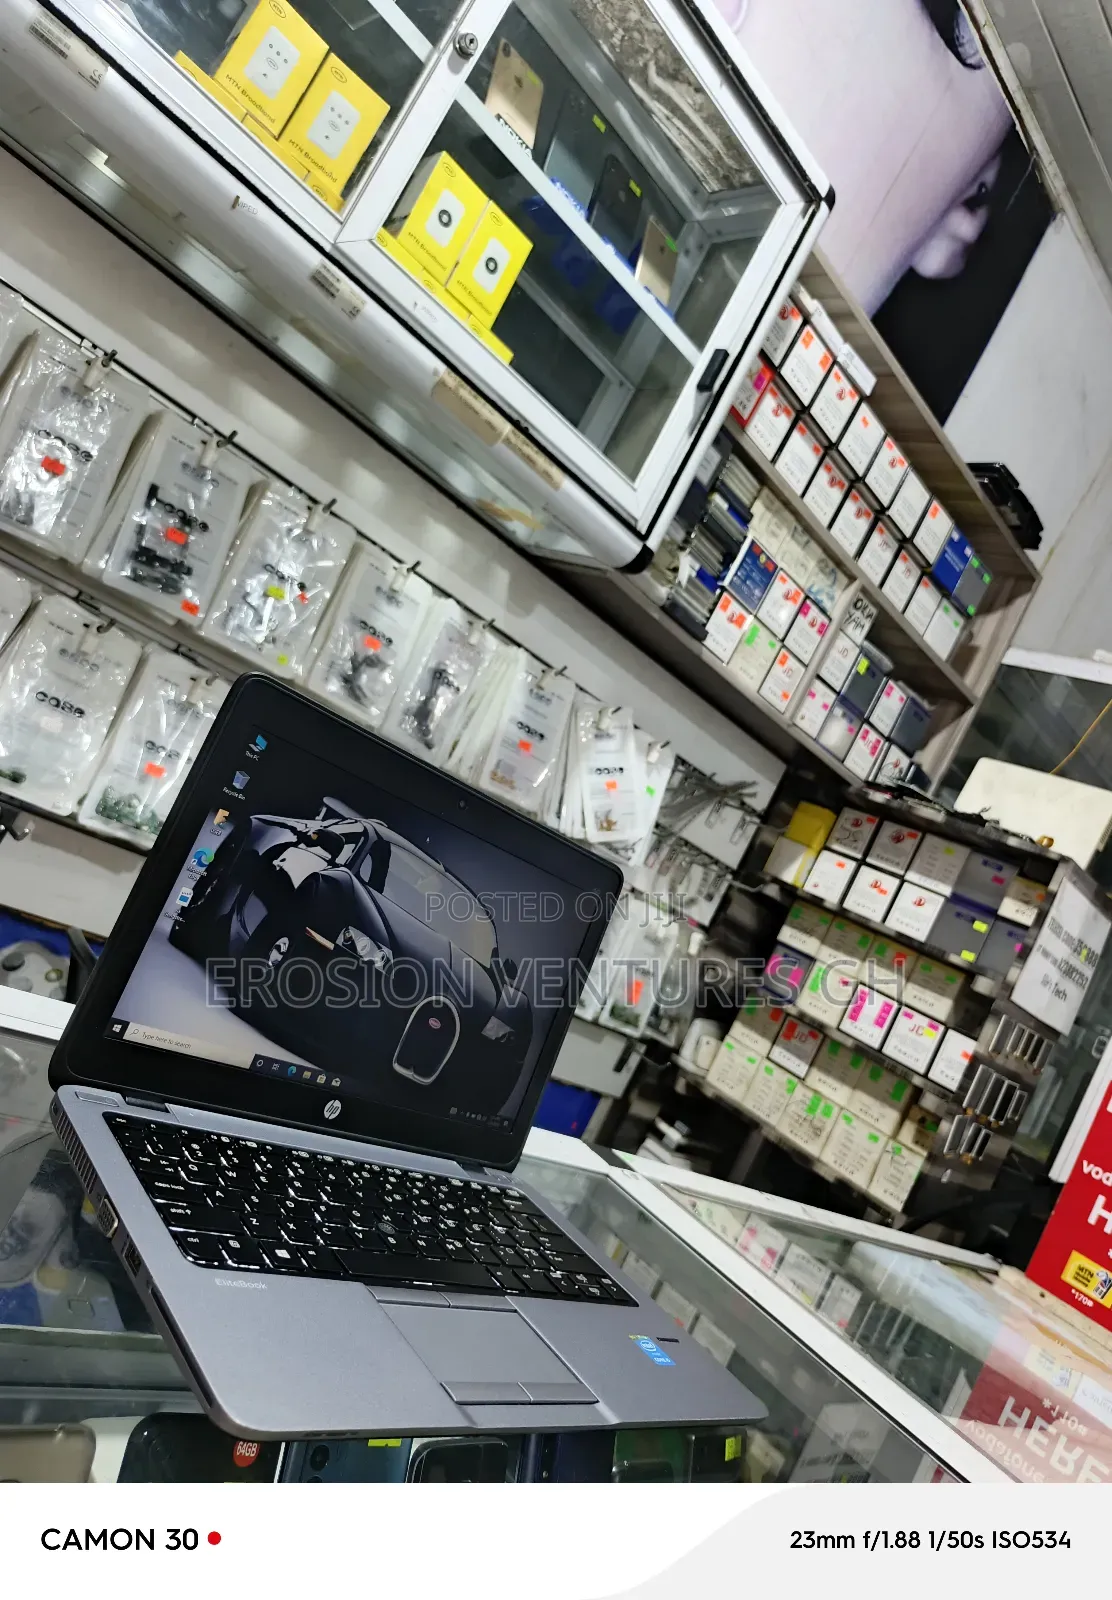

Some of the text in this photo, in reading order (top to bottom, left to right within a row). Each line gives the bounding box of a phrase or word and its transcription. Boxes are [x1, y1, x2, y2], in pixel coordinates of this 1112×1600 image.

[226, 73, 241, 90] MTN
[35, 690, 85, 719] case
[174, 1041, 192, 1049] search
[1077, 1264, 1095, 1279] MTN
[214, 1277, 268, 1291] EliteBook
[236, 1441, 258, 1457] 64GB
